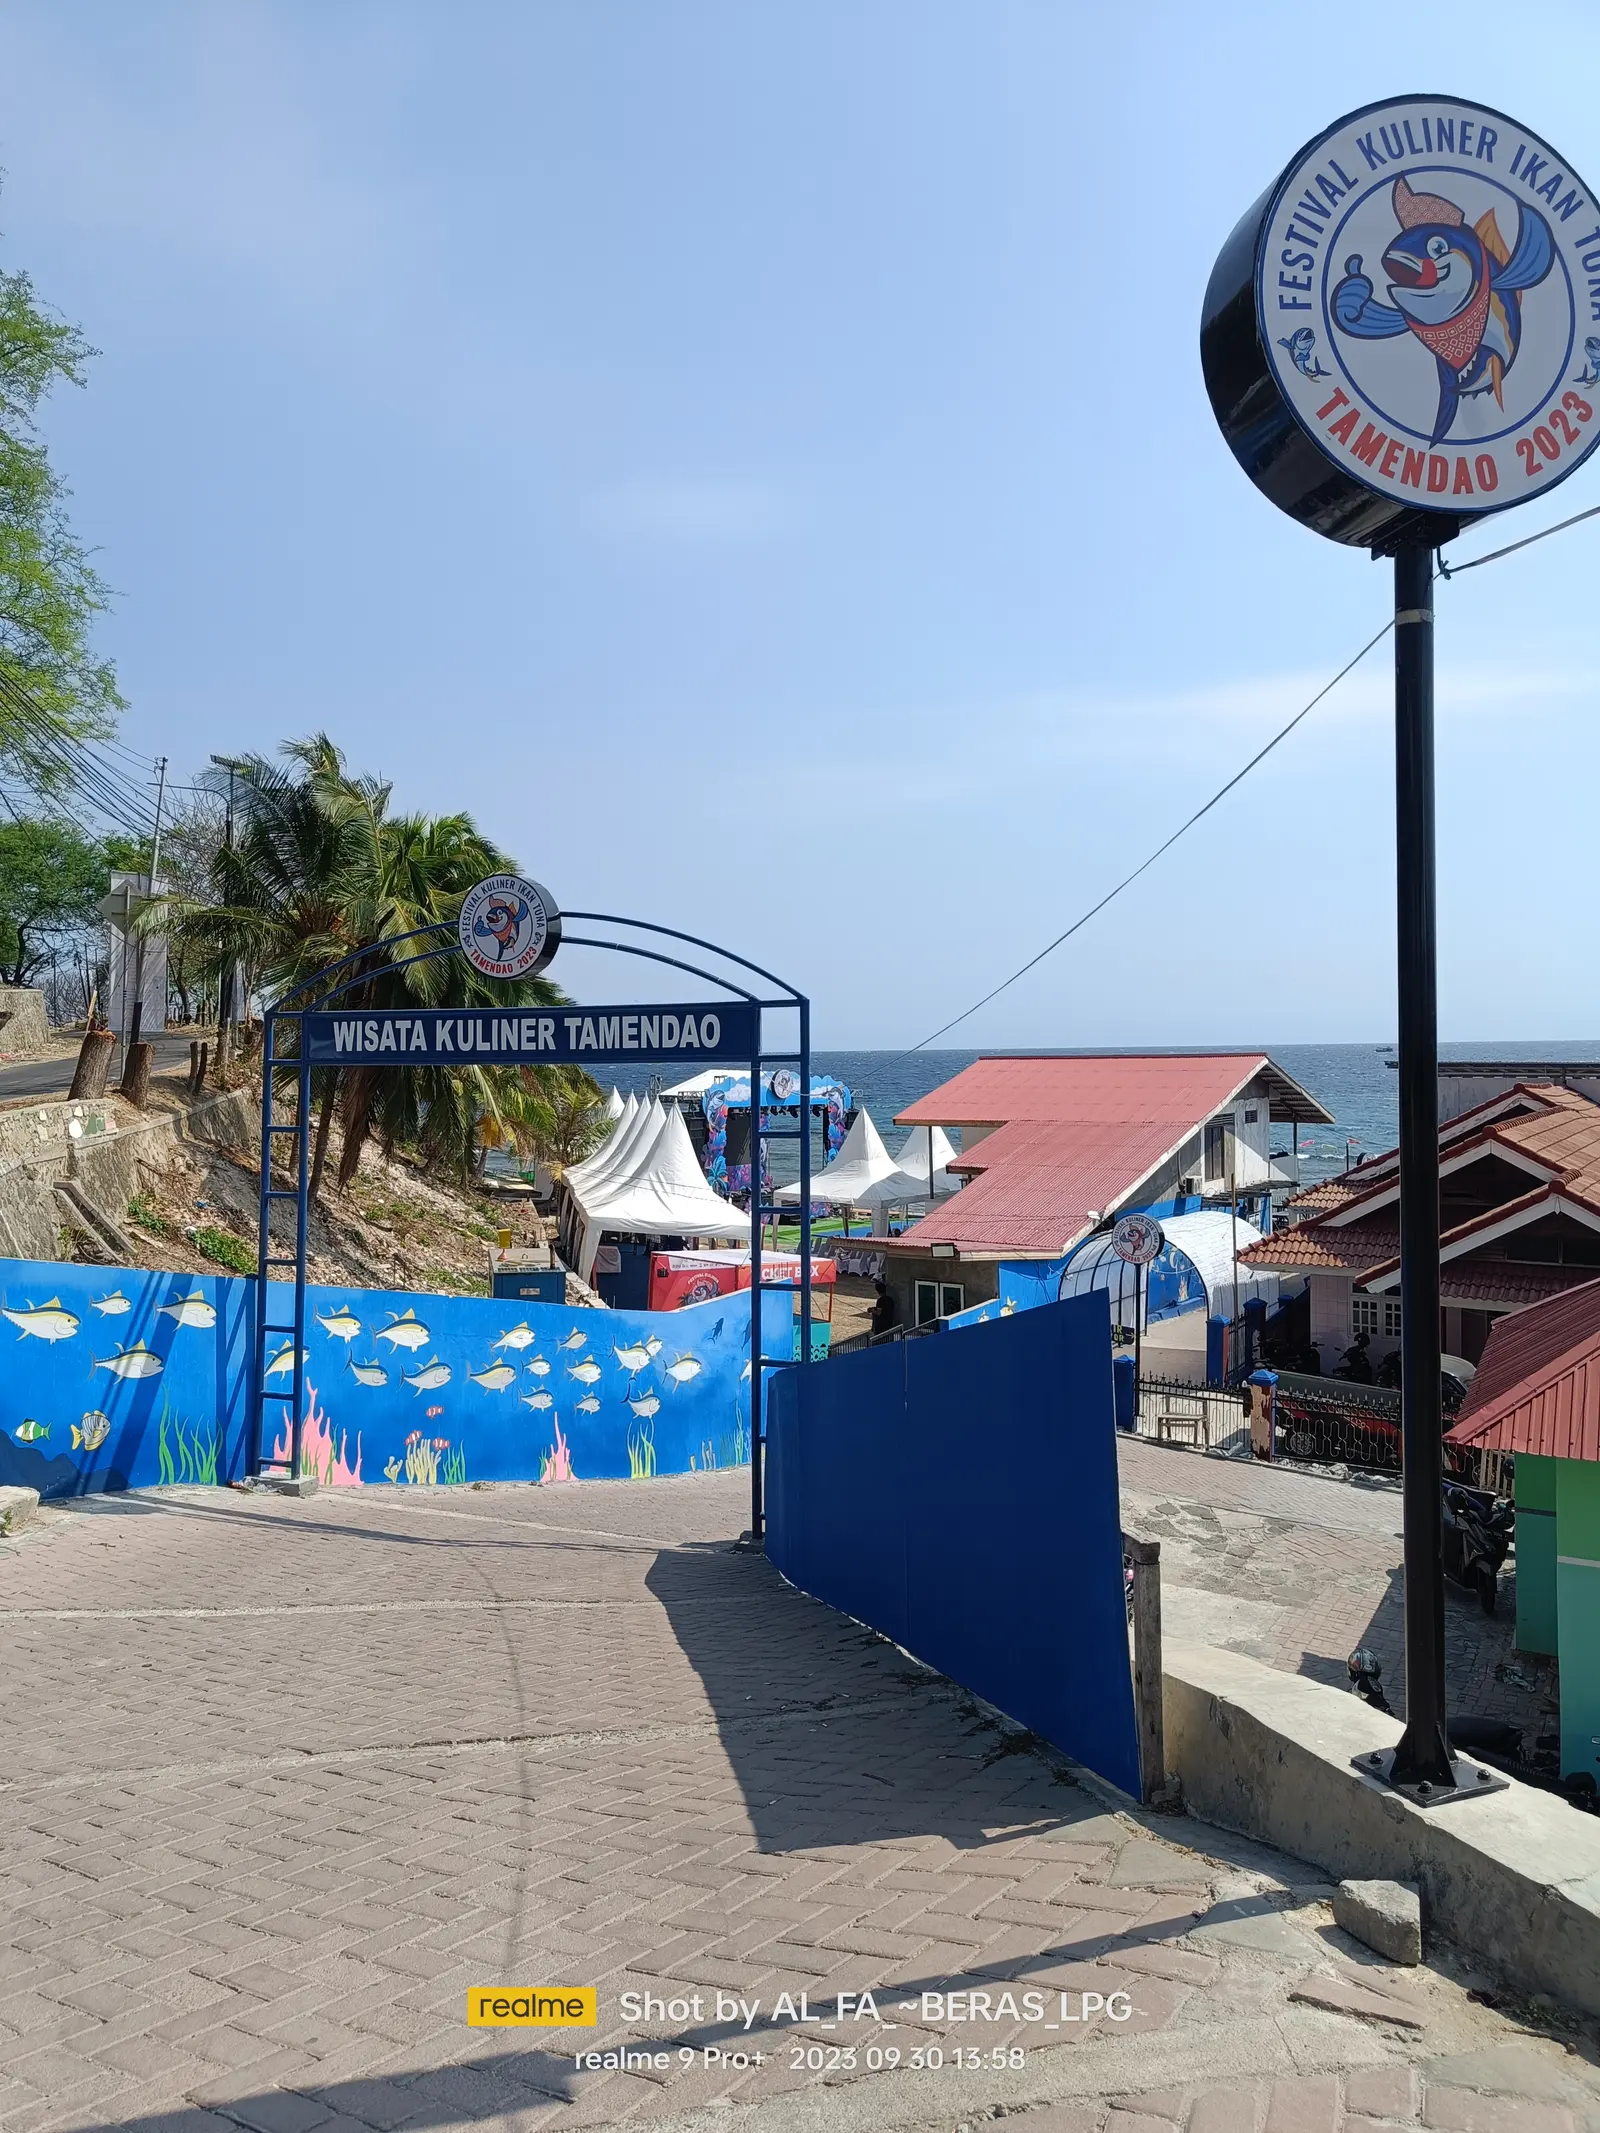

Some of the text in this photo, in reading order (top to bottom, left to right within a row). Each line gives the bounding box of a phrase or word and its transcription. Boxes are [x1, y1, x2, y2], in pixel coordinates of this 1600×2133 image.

[1278, 158, 1359, 310] FESTIVAL
[1355, 116, 1499, 171] KULINER
[1509, 143, 1584, 223] IKAN
[1315, 386, 1594, 495] TAMENDAO 2023
[462, 879, 545, 931] FESTIVAL KULINER IKAN TUNA
[470, 946, 537, 974] TAMENDAO 2023
[333, 1013, 721, 1052] WISATA KULINER TAMENDAO
